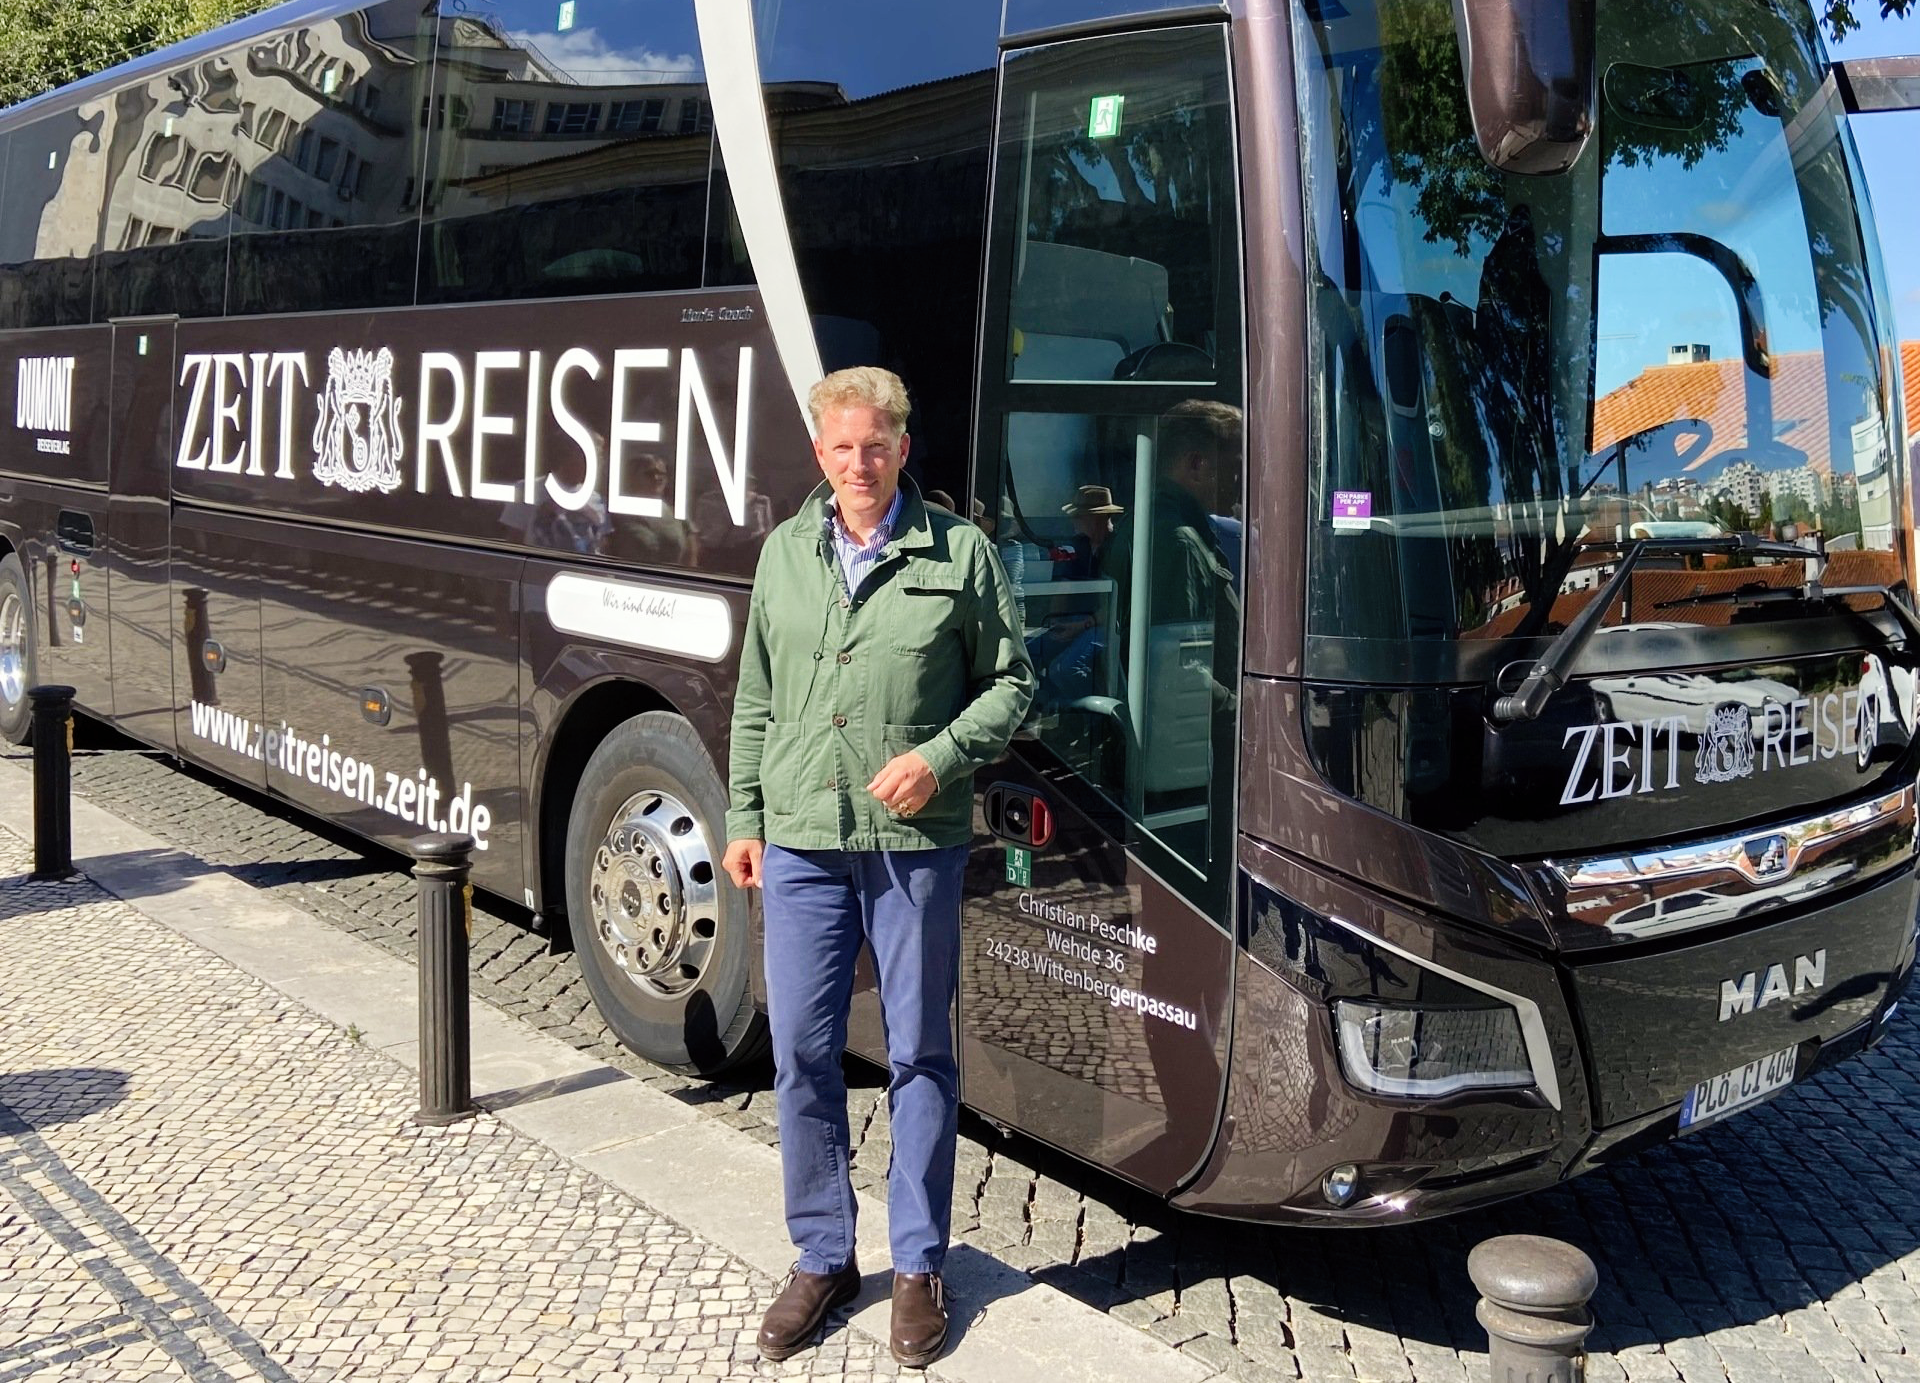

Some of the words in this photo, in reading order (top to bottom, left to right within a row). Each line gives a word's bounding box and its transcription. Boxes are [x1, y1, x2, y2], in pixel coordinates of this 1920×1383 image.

[17, 357, 75, 431] DUMONT
[176, 352, 310, 479] ZEIT
[415, 347, 752, 527] REISEN
[602, 587, 619, 609] Wir
[622, 595, 645, 613] sind
[646, 597, 677, 619] dabei!
[191, 699, 491, 850] www.zeitreisen.zeit.de
[1559, 714, 1689, 805] ZEIT
[1762, 688, 1879, 771] REISEN
[1018, 892, 1086, 931] Christian
[1090, 913, 1158, 954] Peschke
[1046, 928, 1101, 965] Wehde
[1104, 948, 1126, 973] 36
[986, 937, 1030, 969] 24238
[1032, 952, 1197, 1031] Wittenbergerpassau
[1717, 948, 1827, 1022] MAN
[1694, 1072, 1732, 1118] PLÖ
[1741, 1058, 1764, 1098] CI
[1766, 1045, 1796, 1087] 404
